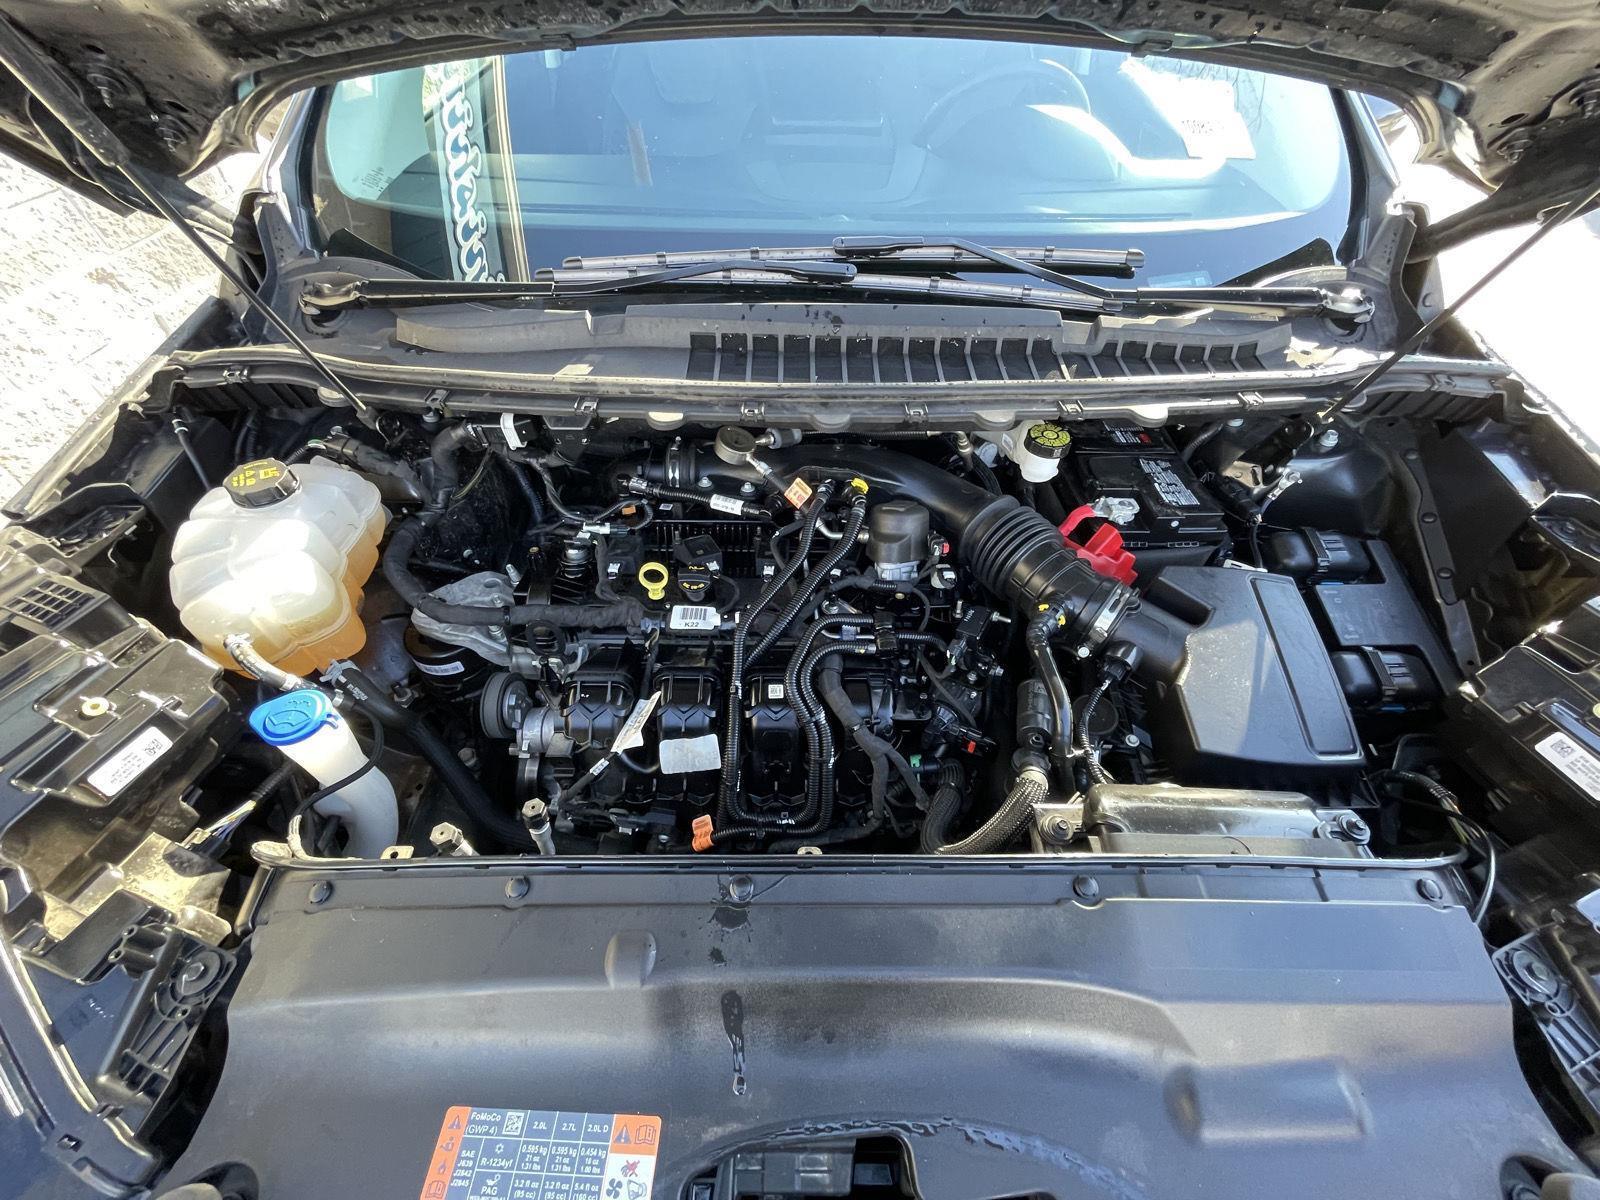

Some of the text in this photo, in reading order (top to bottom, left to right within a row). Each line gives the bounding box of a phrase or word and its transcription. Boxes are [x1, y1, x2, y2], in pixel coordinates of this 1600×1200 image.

[471, 1112, 501, 1122] FoMoCo
[465, 1126, 498, 1136] (GWP 4)
[533, 1122, 547, 1131] 2.0L
[562, 1124, 576, 1132] 2.7L
[588, 1124, 602, 1133] 2.0L
[540, 1148, 548, 1156] kg
[552, 1146, 578, 1157] 0.595 kg
[581, 1148, 607, 1159] 0.454 kg
[481, 1158, 513, 1170] R-1234yf
[515, 1180, 524, 1188] 3.2
[545, 1180, 554, 1189] 3.2
[575, 1182, 584, 1191] 5.4
[482, 1186, 498, 1195] PAG
[526, 1192, 536, 1200] cc)
